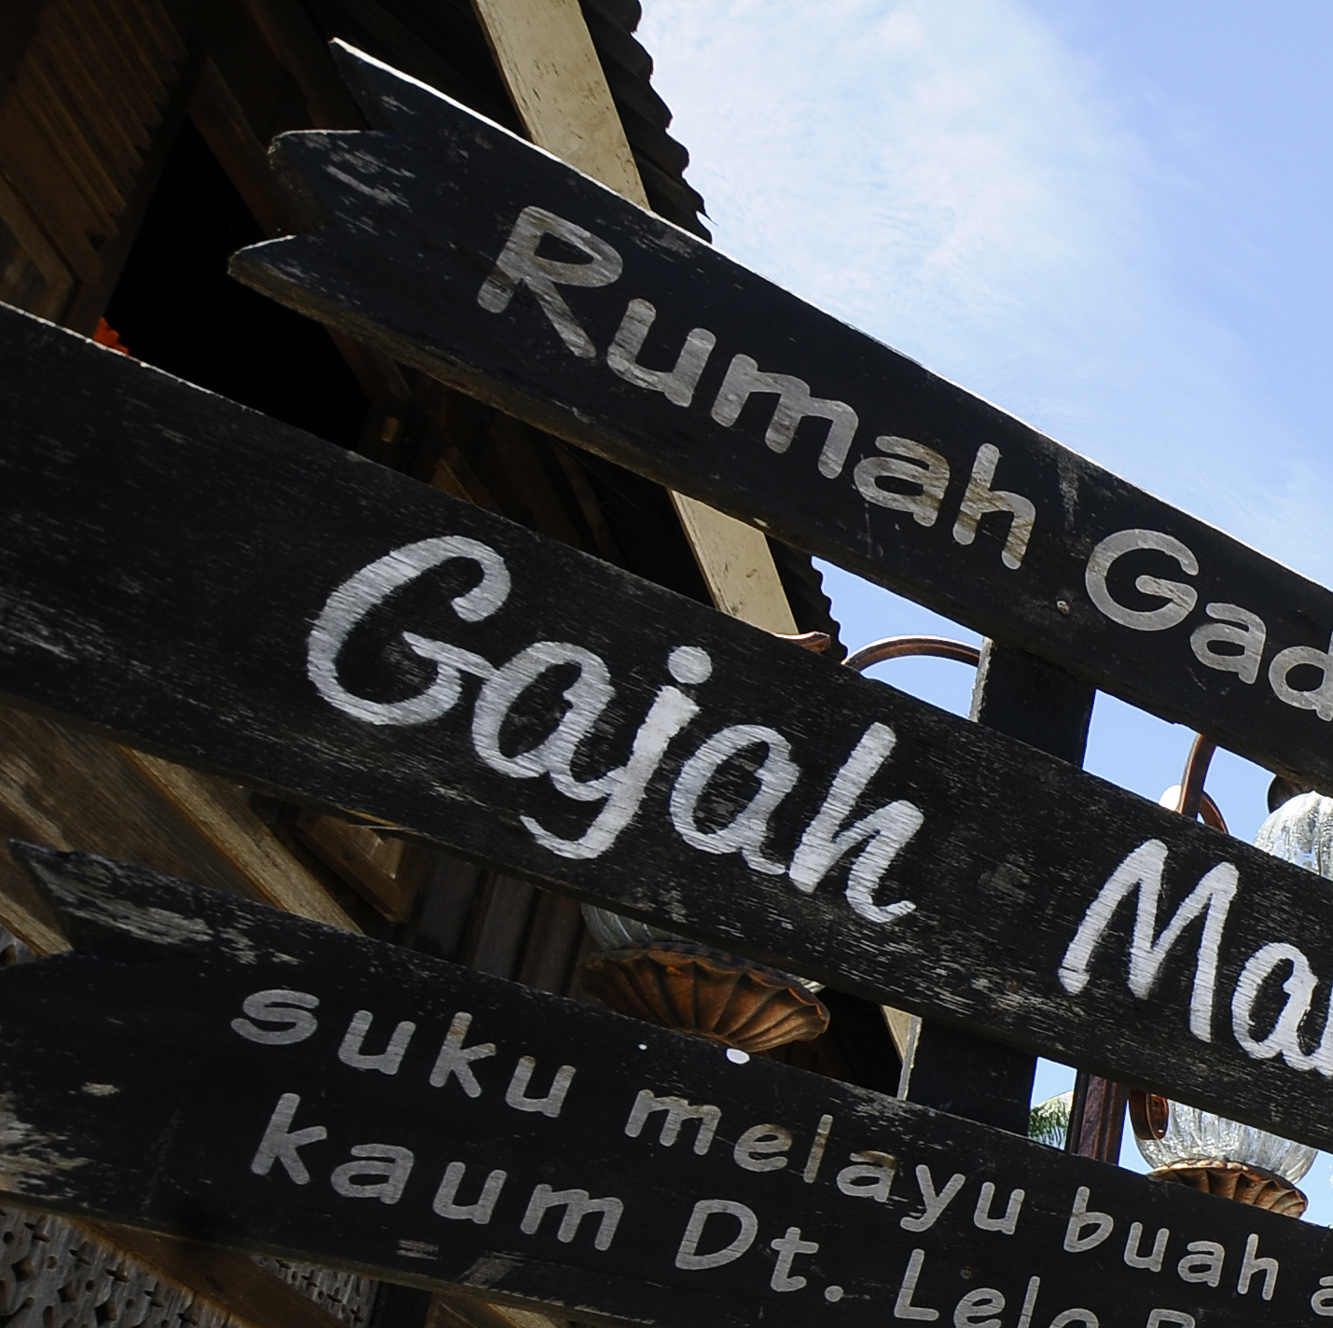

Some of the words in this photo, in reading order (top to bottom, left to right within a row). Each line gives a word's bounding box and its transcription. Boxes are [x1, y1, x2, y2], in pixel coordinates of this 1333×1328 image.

[476, 207, 1037, 570] Rumah
[307, 536, 920, 924] Gajah
[230, 989, 573, 1118] suku
[626, 1089, 1025, 1235] melayu
[1062, 1186, 1280, 1302] buah
[250, 1095, 625, 1253] kaum
[676, 1200, 844, 1304] Dt.
